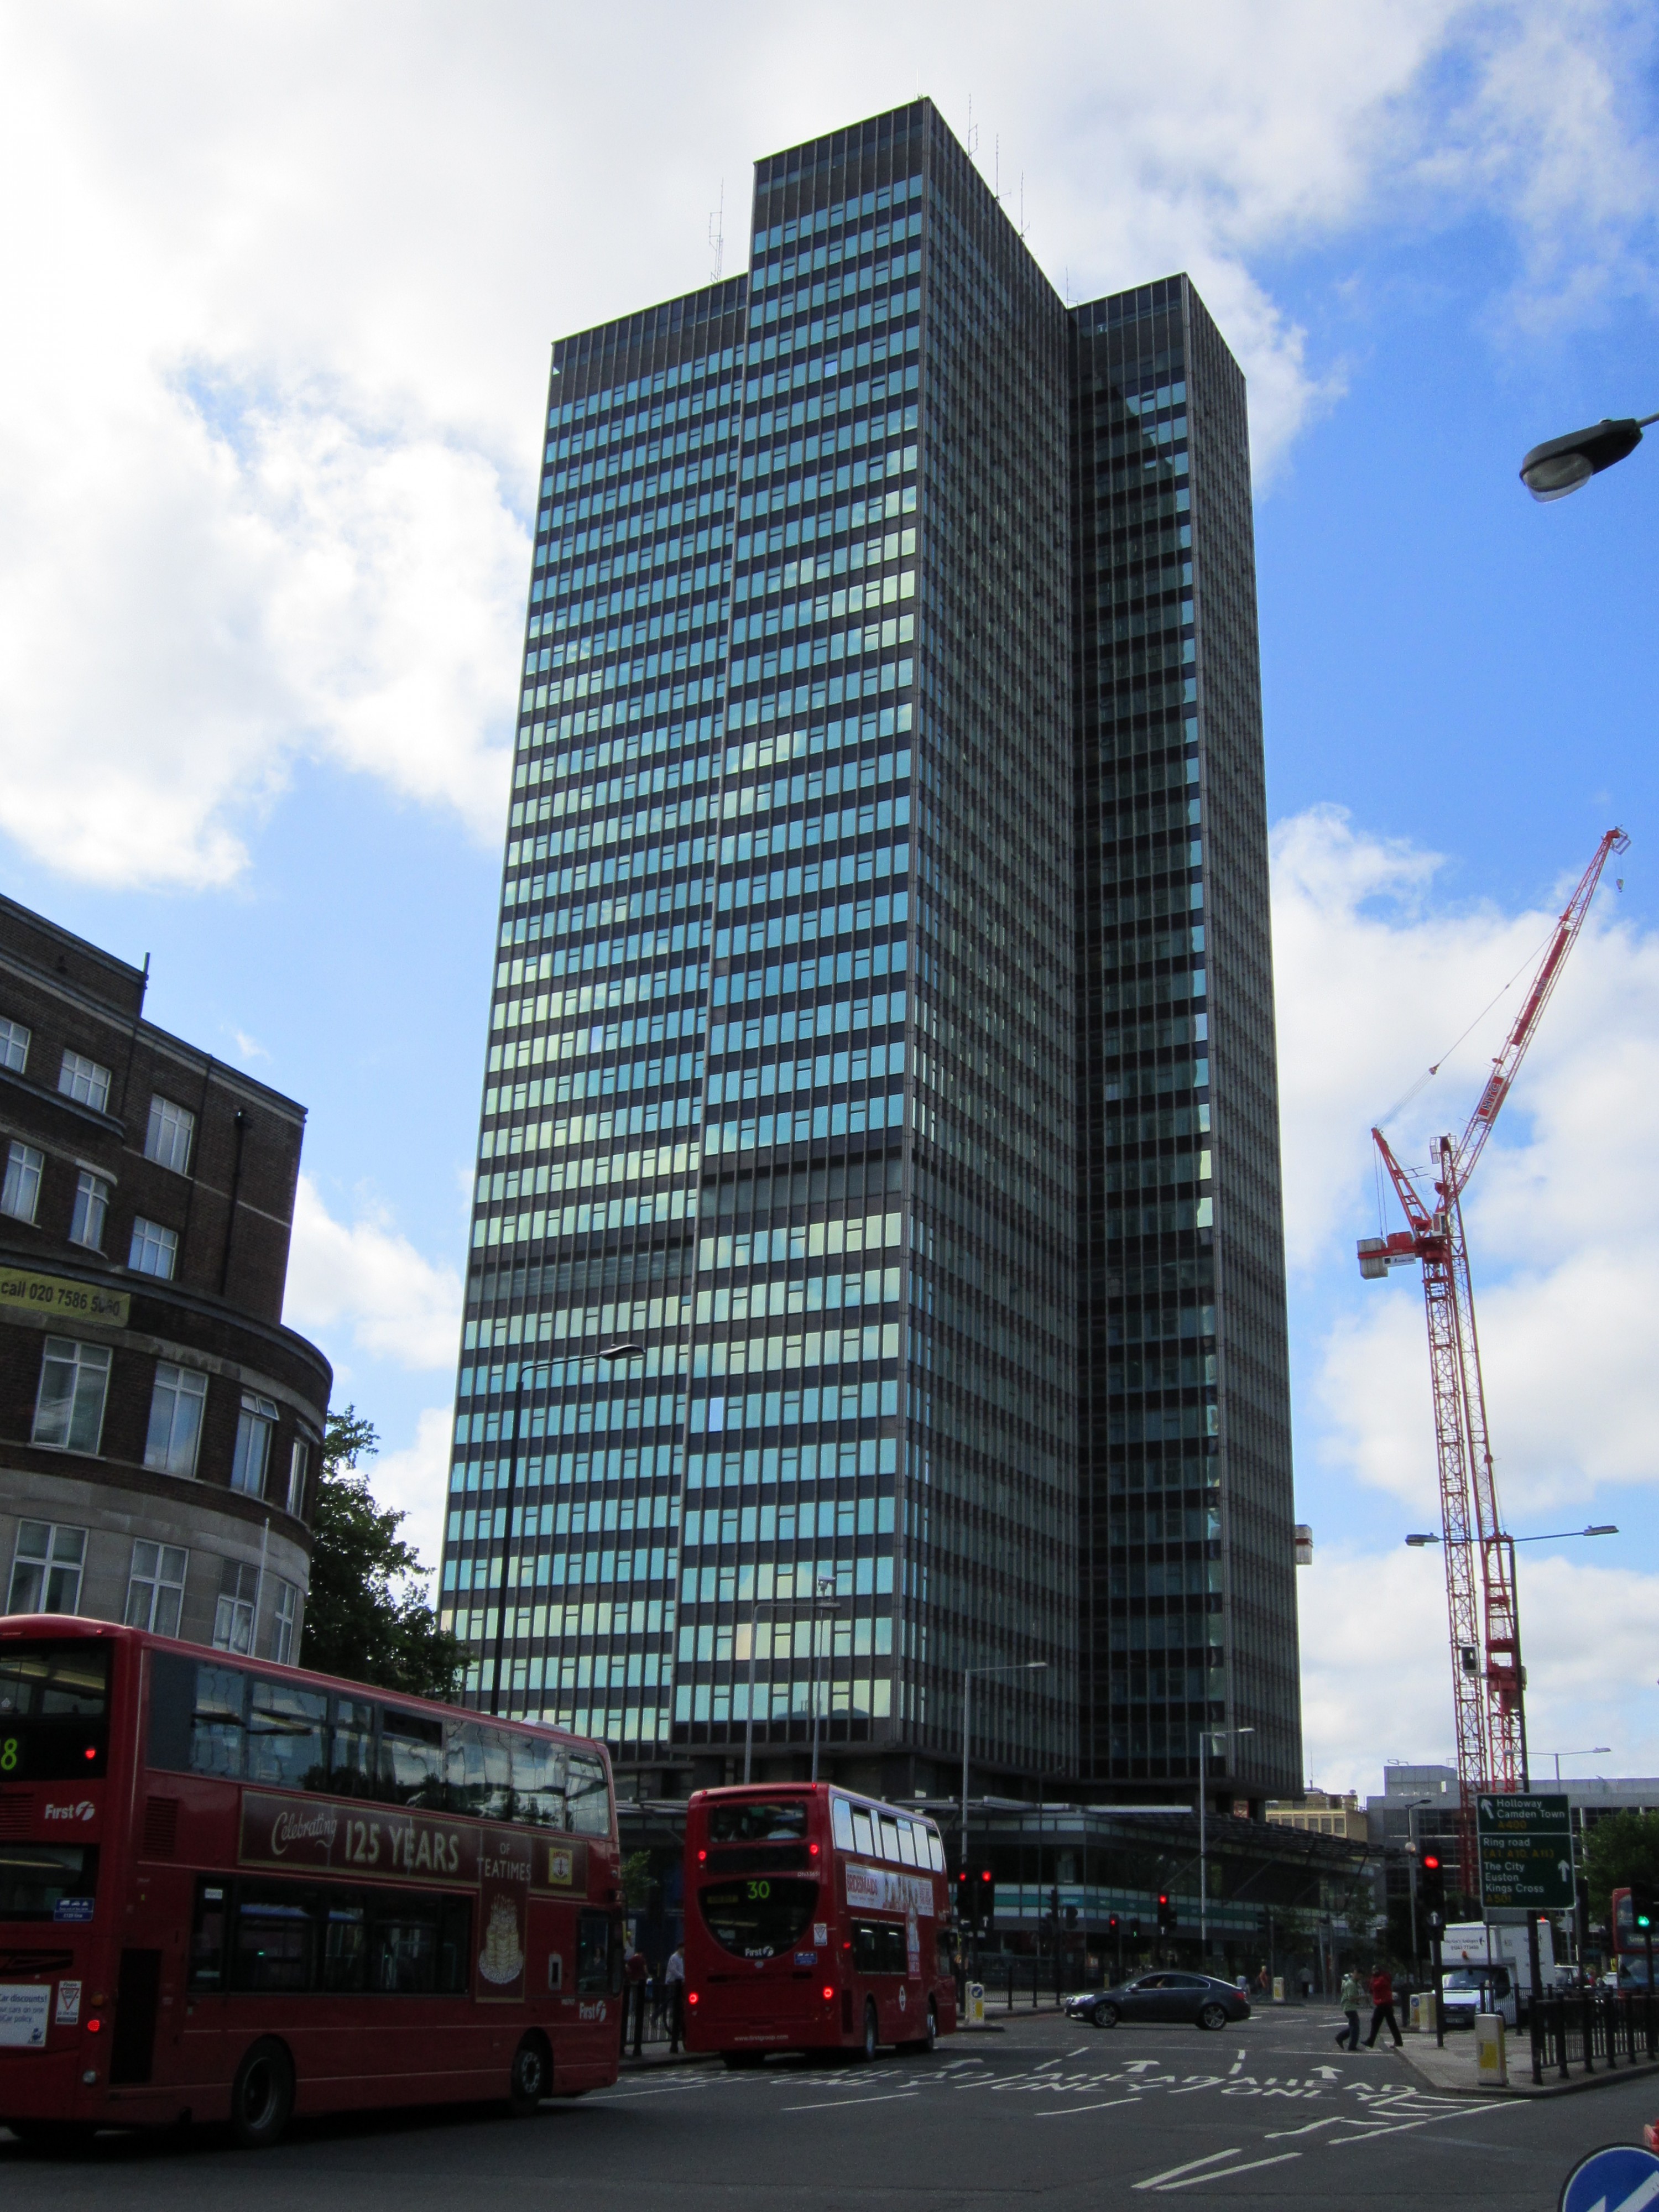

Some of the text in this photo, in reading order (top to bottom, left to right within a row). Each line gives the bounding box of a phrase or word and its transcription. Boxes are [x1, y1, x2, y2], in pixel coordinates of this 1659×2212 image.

[1482, 1082, 1500, 1110] HTC
[1, 1281, 26, 1297] call
[29, 1284, 54, 1302] 020
[58, 1288, 87, 1309] 7586
[1496, 1799, 1542, 1808] Holloway
[44, 1804, 74, 1820] First
[1497, 1809, 1566, 1818] Camden Town
[1498, 1820, 1527, 1829] A400
[271, 1812, 460, 1873] Celebrating 125 YEARS
[1483, 1838, 1531, 1848] Ring road
[499, 1843, 510, 1855] OF
[477, 1858, 531, 1882] TEATIMES
[1484, 1861, 1525, 1872] The City
[1485, 1873, 1519, 1881] Euston
[747, 1880, 770, 1900] 30
[1485, 1884, 1545, 1893] Kings Cross
[1486, 1895, 1512, 1903] A501
[745, 1948, 762, 1957] First
[11, 1993, 48, 2002] discounts!
[1025, 2073, 1218, 2083] AHEAD
[990, 2082, 1164, 2092] ONLY
[1228, 2077, 1416, 2092] AHEAD
[1221, 2088, 1390, 2101] ONLY
